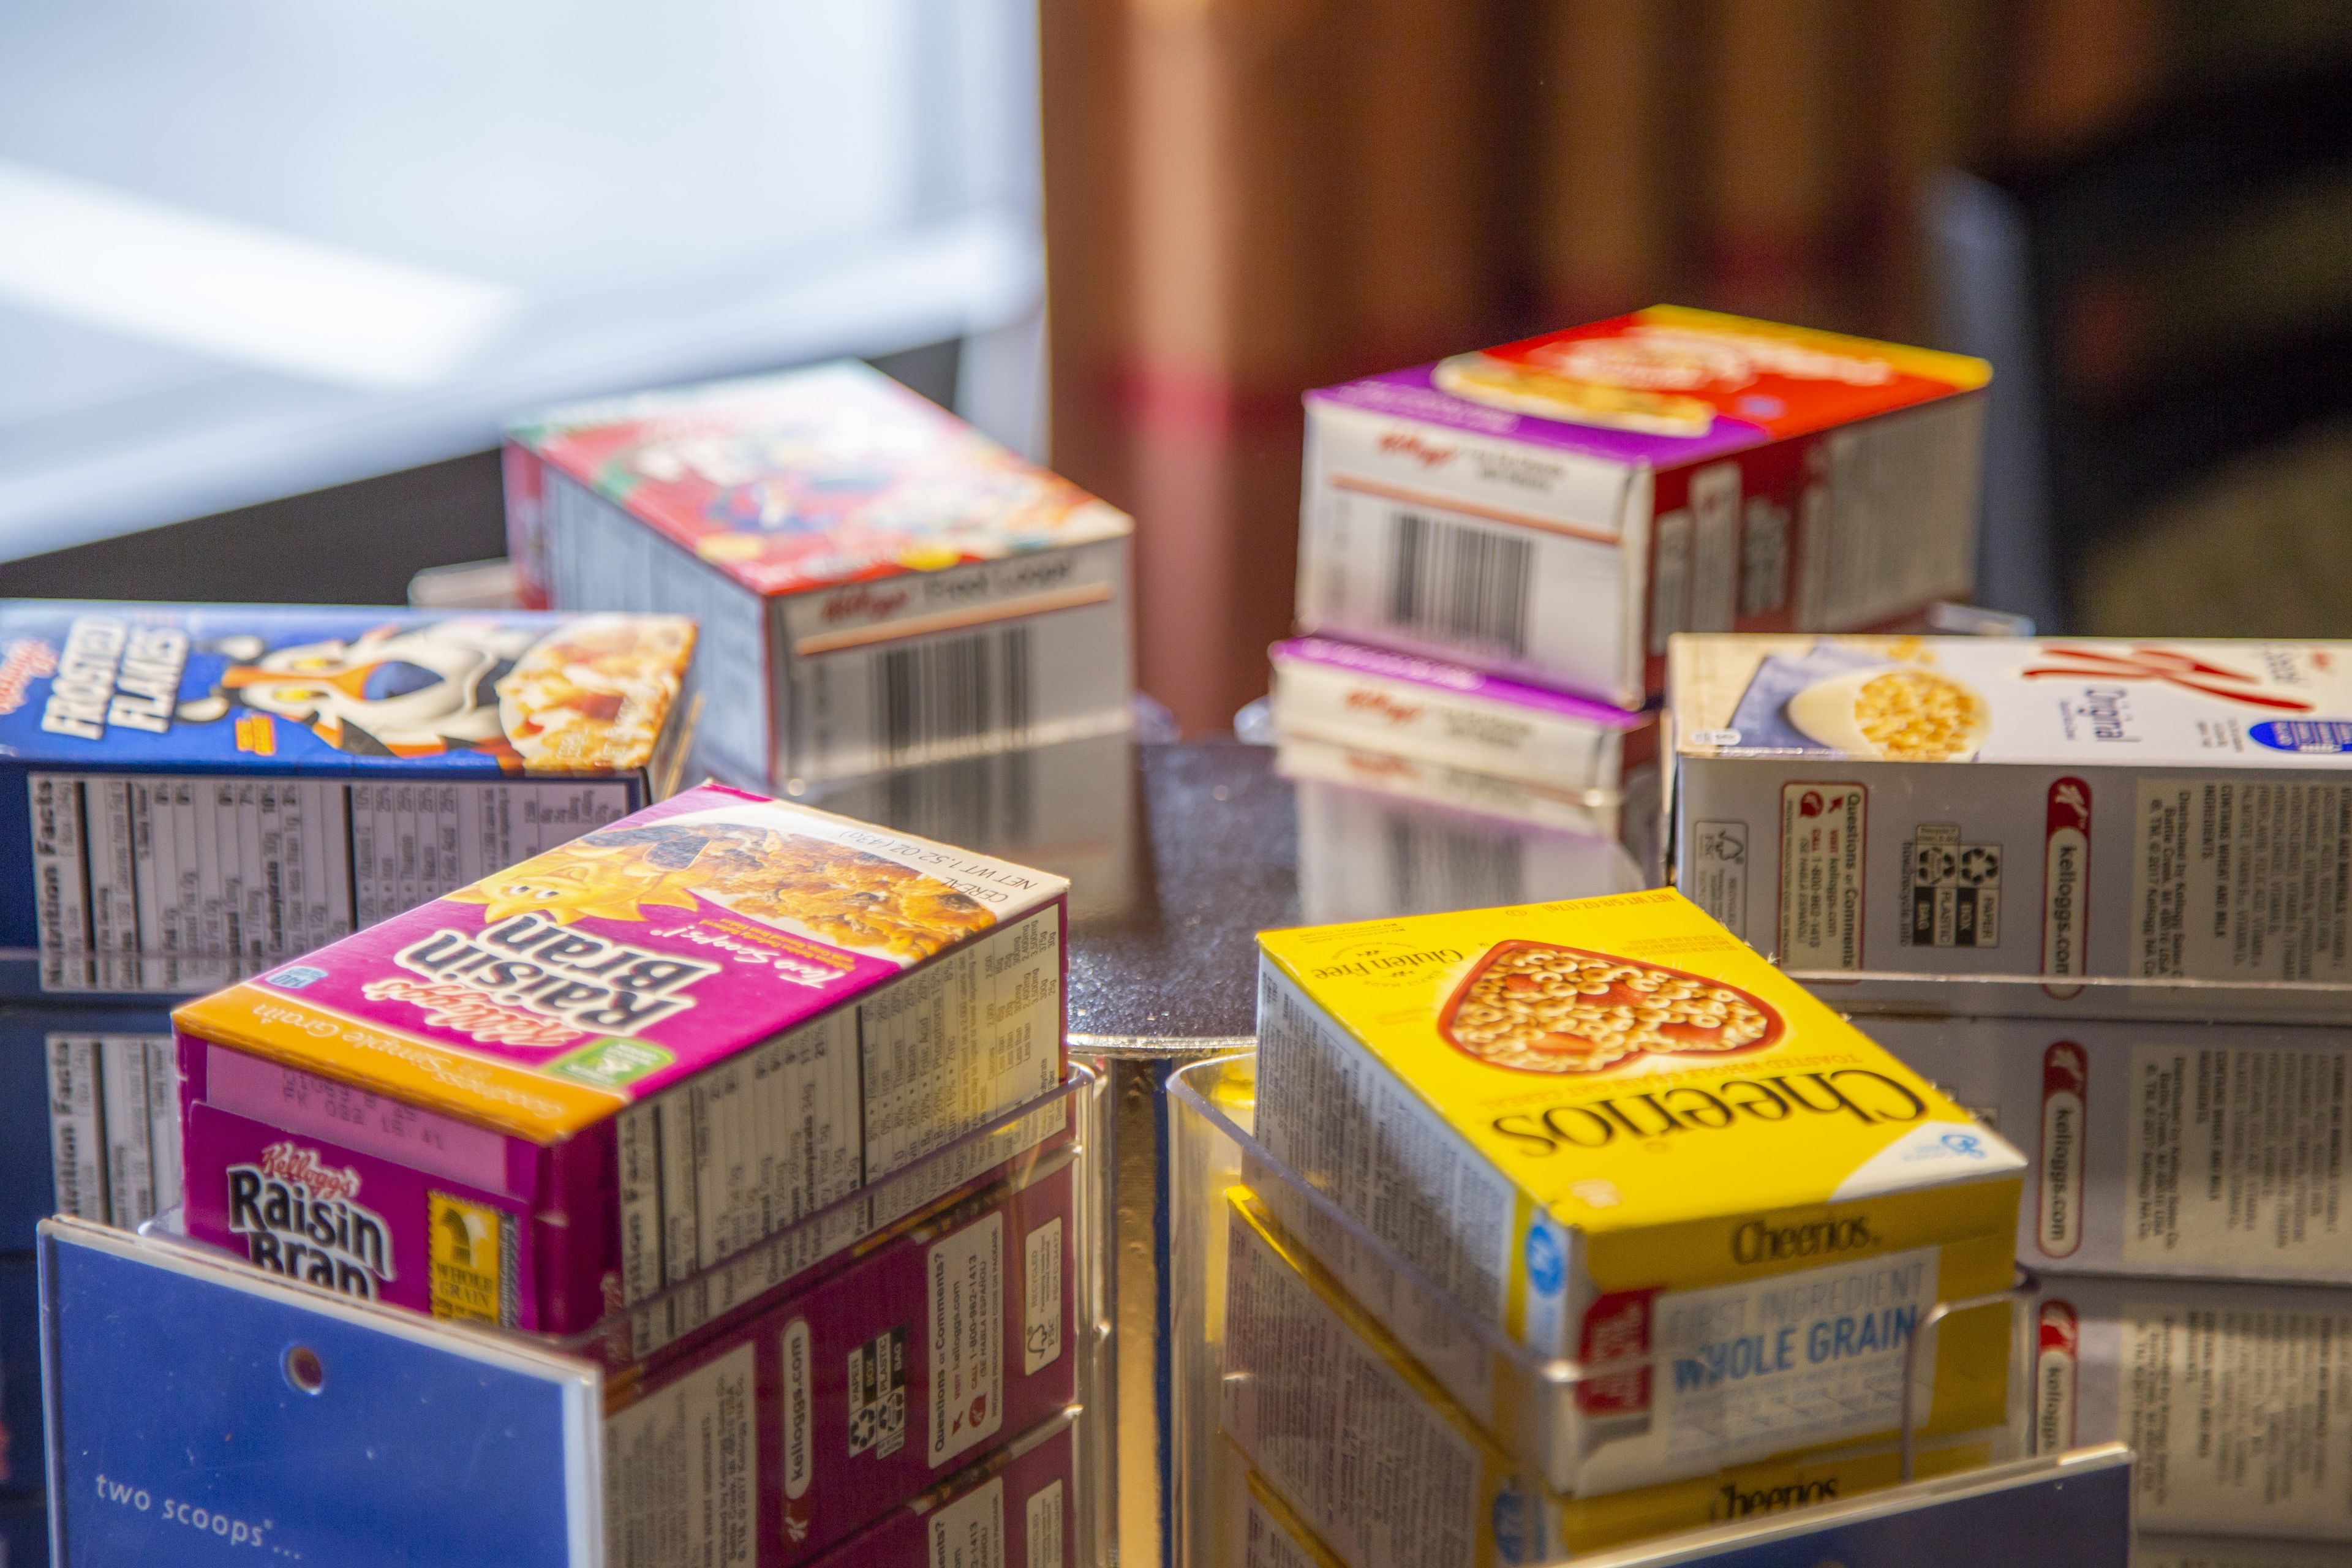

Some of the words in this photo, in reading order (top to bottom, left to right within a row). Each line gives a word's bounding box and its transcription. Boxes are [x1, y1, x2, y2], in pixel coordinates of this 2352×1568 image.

[40, 615, 127, 740] FROSTED
[107, 628, 189, 733] FLAKES
[2078, 687, 2143, 743] Original
[36, 781, 56, 856] Facts
[1847, 793, 1861, 870] Questions
[839, 831, 895, 848] (43g)
[890, 844, 921, 856] OZ
[918, 853, 963, 869] 1.52
[960, 865, 996, 879] WT
[941, 877, 1008, 903] CEREAL
[992, 875, 1038, 889] NET
[1826, 858, 1841, 938] kelloggs.com
[1845, 875, 1854, 886] or
[1623, 895, 1648, 905] WT
[1941, 892, 1952, 943] PLASTIC
[1983, 897, 1994, 938] PAPER
[42, 866, 63, 986] Nutrition
[1022, 925, 1031, 960] 2,400mg
[1030, 919, 1039, 956] 3,500mg
[1039, 931, 1049, 952] 375g
[1047, 932, 1057, 947] 30g
[477, 913, 721, 998] Bran
[1311, 962, 1371, 981] Free
[1370, 949, 1464, 971] Gluten
[397, 930, 693, 1035] Raisin
[774, 960, 845, 988] Two
[1022, 973, 1032, 1008] 2,400mg
[1031, 968, 1040, 1003] 3,500mg
[1039, 979, 1049, 1000] 300g
[1048, 979, 1057, 996] 25g
[252, 1003, 339, 1038] Grain
[919, 1017, 929, 1043] Acid
[932, 996, 944, 1070] Phosphorus
[342, 1030, 451, 1072] Simple
[892, 1040, 903, 1090] Thiamin
[907, 1044, 916, 1083] Niacin
[919, 1047, 930, 1077] Folic
[945, 1036, 956, 1063] Zinc
[1765, 1054, 1863, 1069] TOASTED
[879, 1070, 890, 1095] Iron
[1612, 1069, 1684, 1088] GRAIN
[1685, 1060, 1765, 1076] WHOLE
[932, 1086, 944, 1114] 20%
[945, 1080, 957, 1106] 15%
[1566, 1083, 1610, 1096] OAT
[905, 1100, 918, 1129] 20%
[919, 1093, 930, 1122] 20%
[1493, 1071, 1929, 1158] Cheerios
[263, 1142, 361, 1199] Kellogg's
[2048, 1107, 2073, 1240] kelloggs.com
[227, 1165, 396, 1281] Raisin
[1731, 1216, 1868, 1265] Cheerios
[249, 1231, 377, 1302] Bran
[435, 1262, 493, 1288] WHOLE
[440, 1281, 489, 1307] GRAIN
[934, 1253, 946, 1349] Comments?
[1760, 1261, 1926, 1317] INGREDIENT
[968, 1255, 978, 1359] 1-800-962-1413
[952, 1281, 962, 1370] kelloggs.com
[879, 1337, 888, 1393] PLASTIC
[938, 1353, 945, 1364] or
[1672, 1329, 1796, 1392] WHOLE
[1808, 1303, 1917, 1363] GRAIN
[791, 1336, 805, 1481] kelloggs.com
[934, 1368, 946, 1452] Questions
[96, 1474, 151, 1511] two
